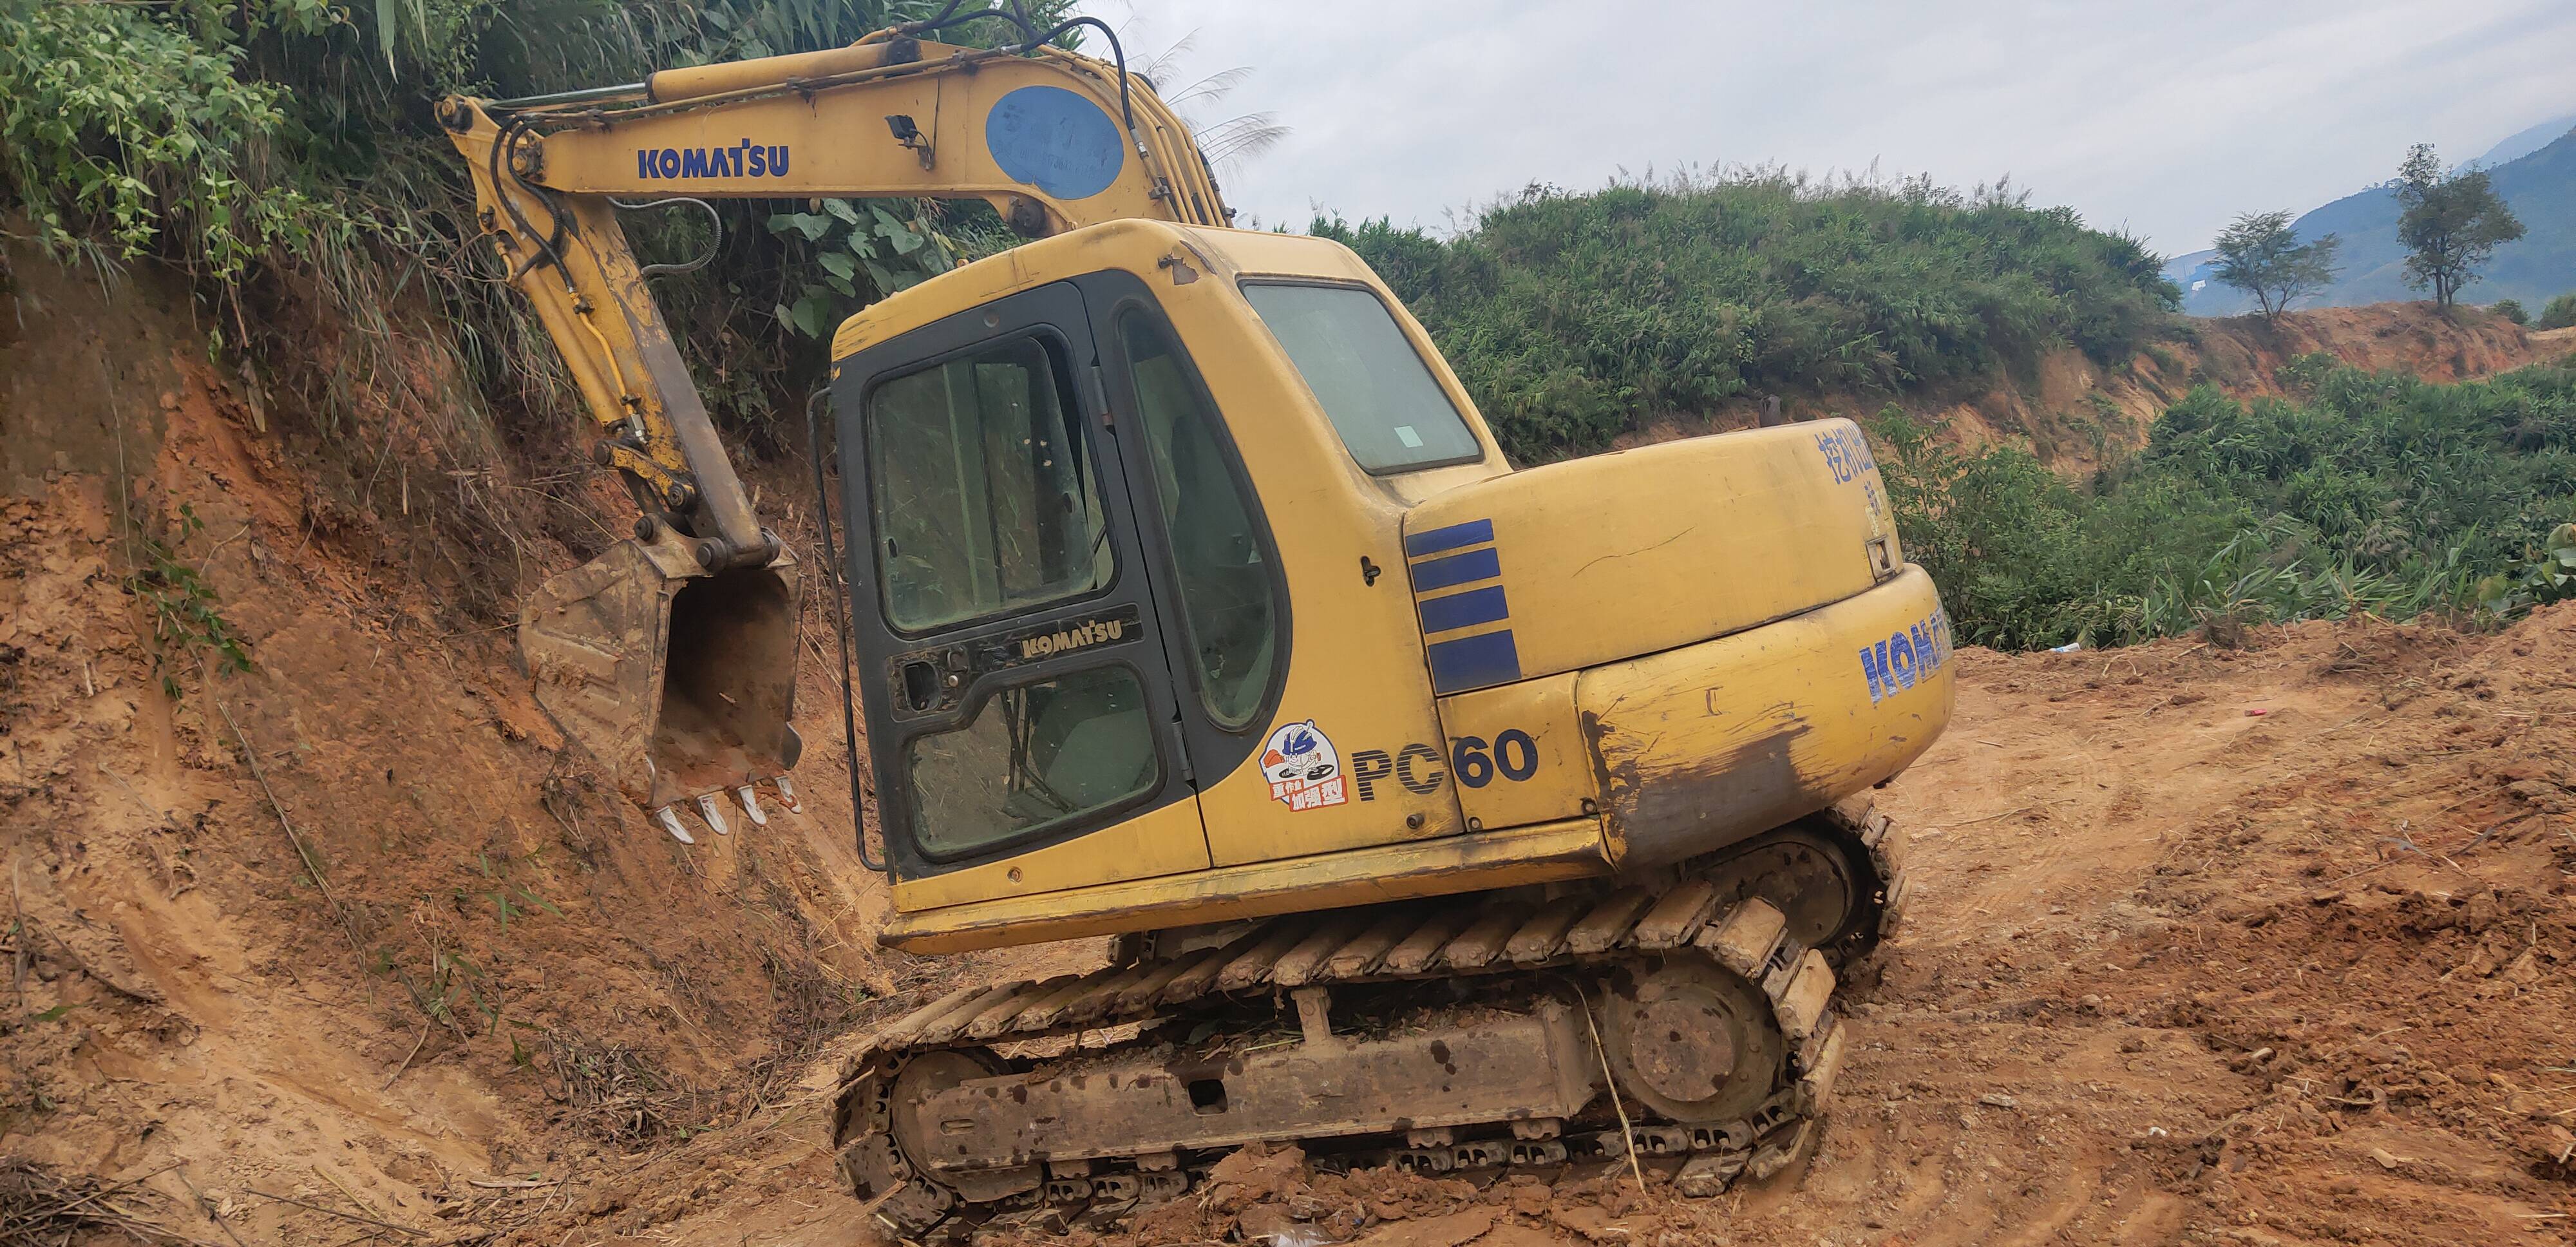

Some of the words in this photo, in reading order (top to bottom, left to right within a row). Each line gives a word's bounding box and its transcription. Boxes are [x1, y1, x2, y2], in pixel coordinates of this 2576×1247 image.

[638, 138, 789, 178] KOMATSU
[1021, 620, 1122, 659] KOMATSU
[1291, 777, 1345, 810] 加强型
